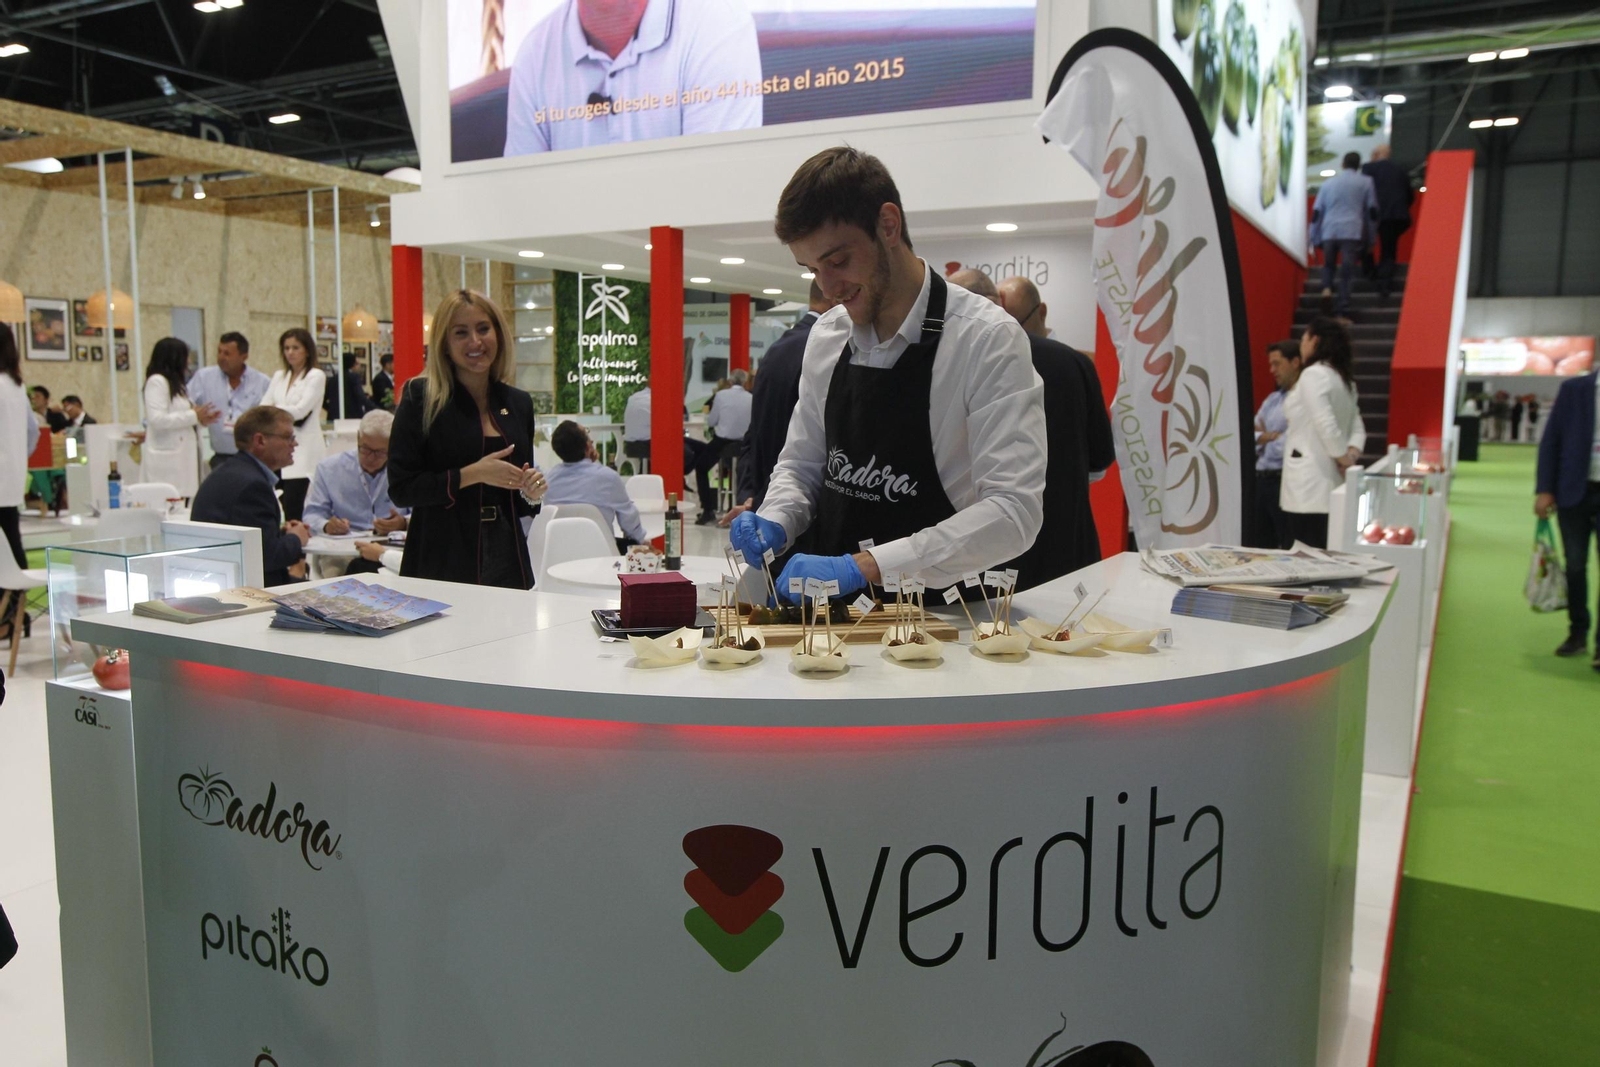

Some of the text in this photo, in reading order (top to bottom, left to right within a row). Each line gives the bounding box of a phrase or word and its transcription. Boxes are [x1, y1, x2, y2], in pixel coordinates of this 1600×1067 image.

[534, 56, 905, 125] si tu coges desde el año 44 hasta el año 2015
[845, 488, 854, 497] EL
[854, 490, 881, 503] SABOR
[74, 708, 97, 727] CASI
[811, 785, 1225, 969] verdita
